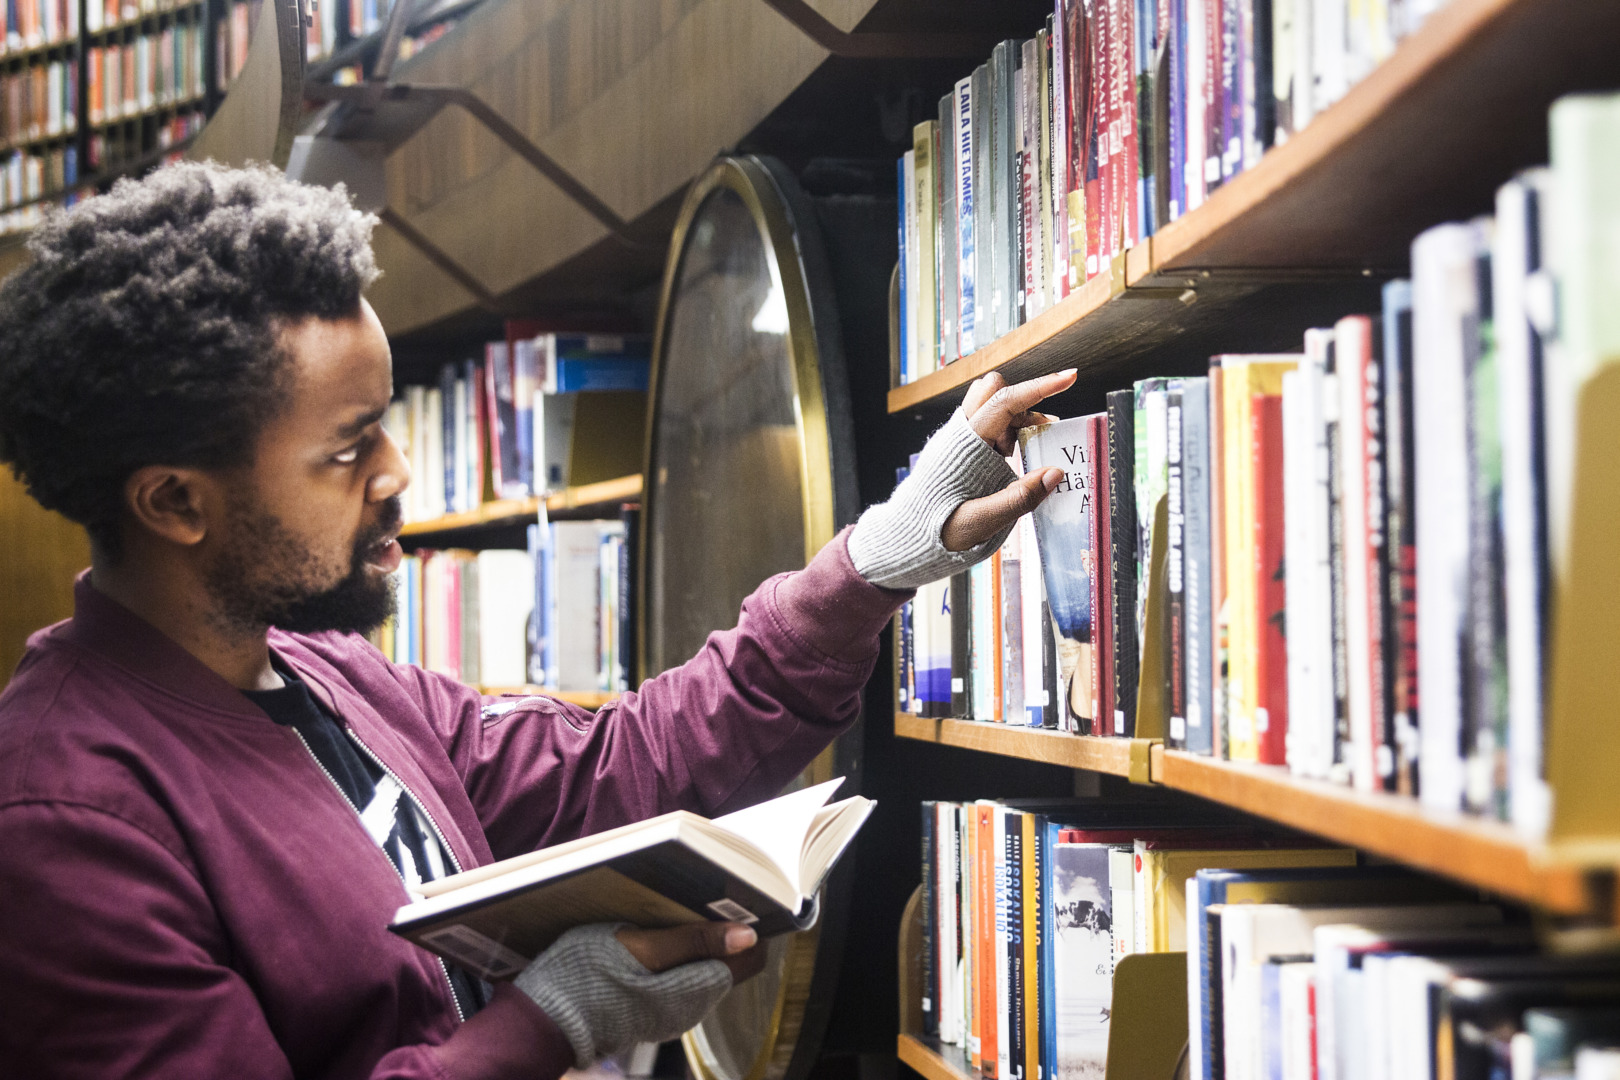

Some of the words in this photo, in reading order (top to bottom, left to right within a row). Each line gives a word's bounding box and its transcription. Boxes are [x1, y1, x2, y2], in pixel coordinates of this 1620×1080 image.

[960, 83, 971, 129] LAILA
[960, 130, 973, 216] HIETAMIES
[1023, 151, 1036, 296] KARHUNPESÄ
[1055, 472, 1089, 494] Hä
[1108, 405, 1118, 516] HÄMÄLÄINEN
[995, 865, 1007, 933] ISOKALLIO
[1006, 859, 1014, 943] ISOKALLIO
[1013, 860, 1021, 945] ISOKALLIO
